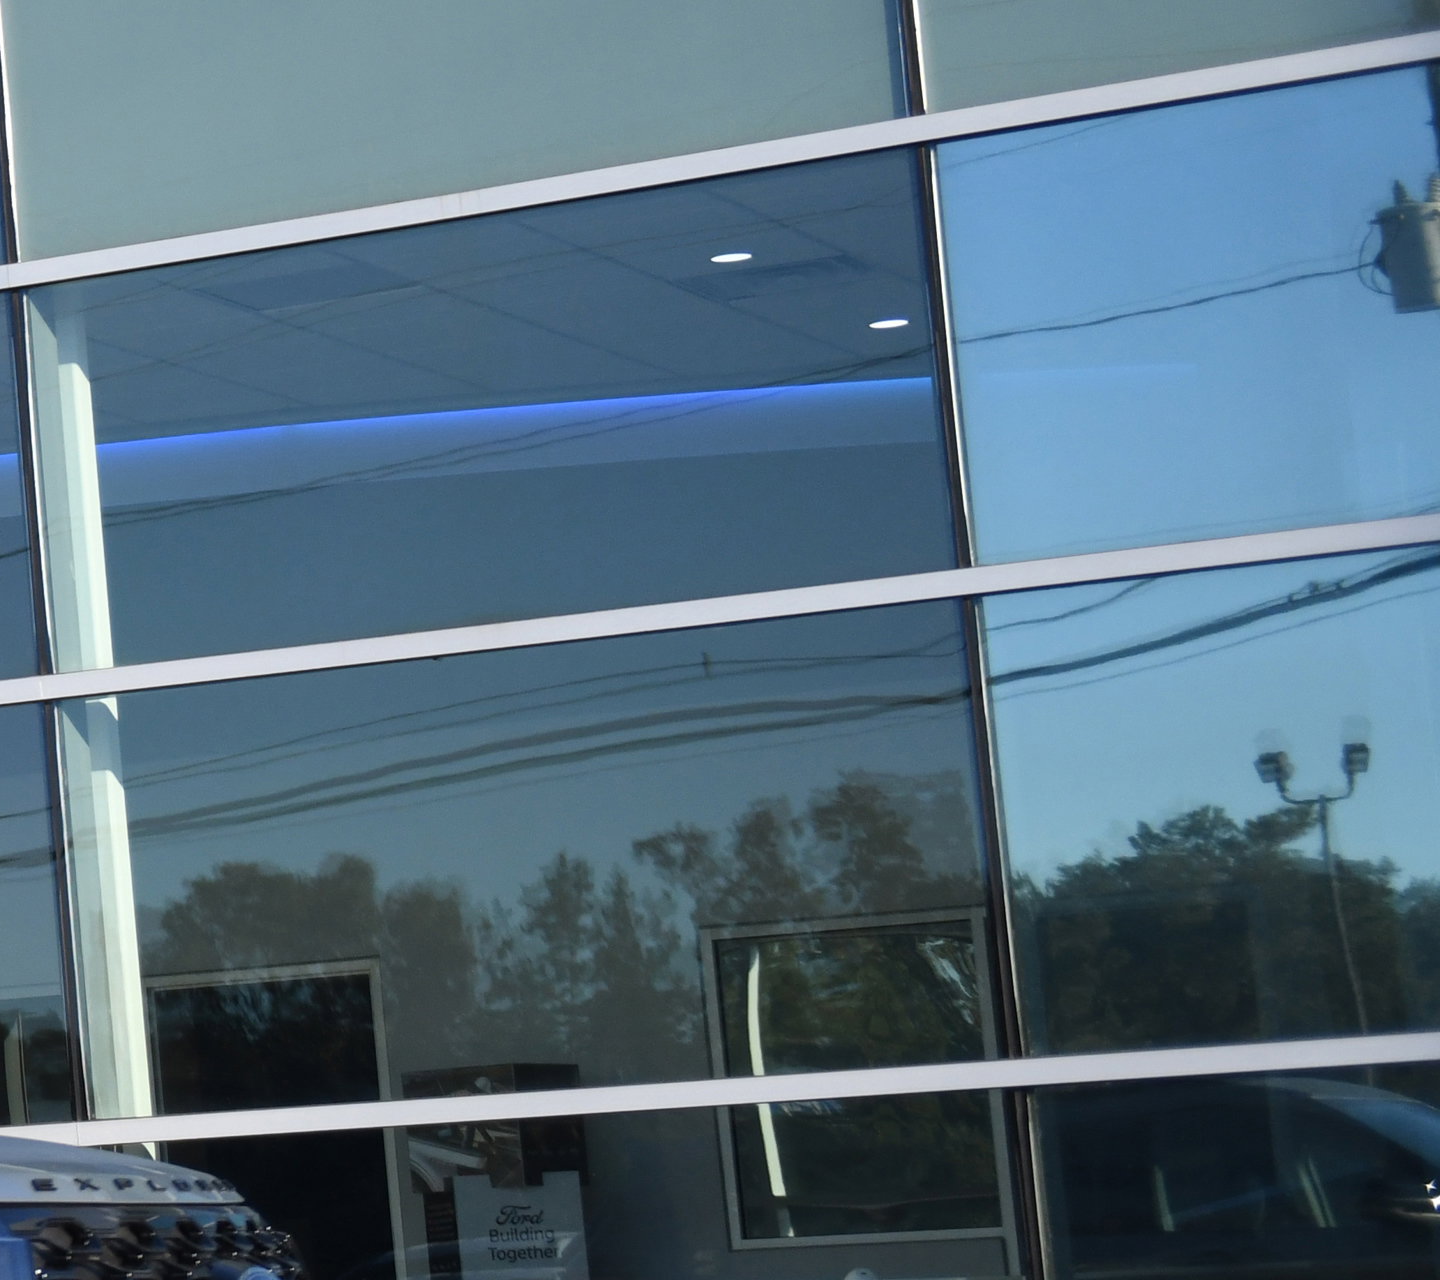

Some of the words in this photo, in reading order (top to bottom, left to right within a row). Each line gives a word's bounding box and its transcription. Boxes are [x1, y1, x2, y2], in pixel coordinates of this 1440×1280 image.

[495, 1205, 544, 1226] Ford
[488, 1228, 556, 1243] Building
[487, 1246, 559, 1263] Together
